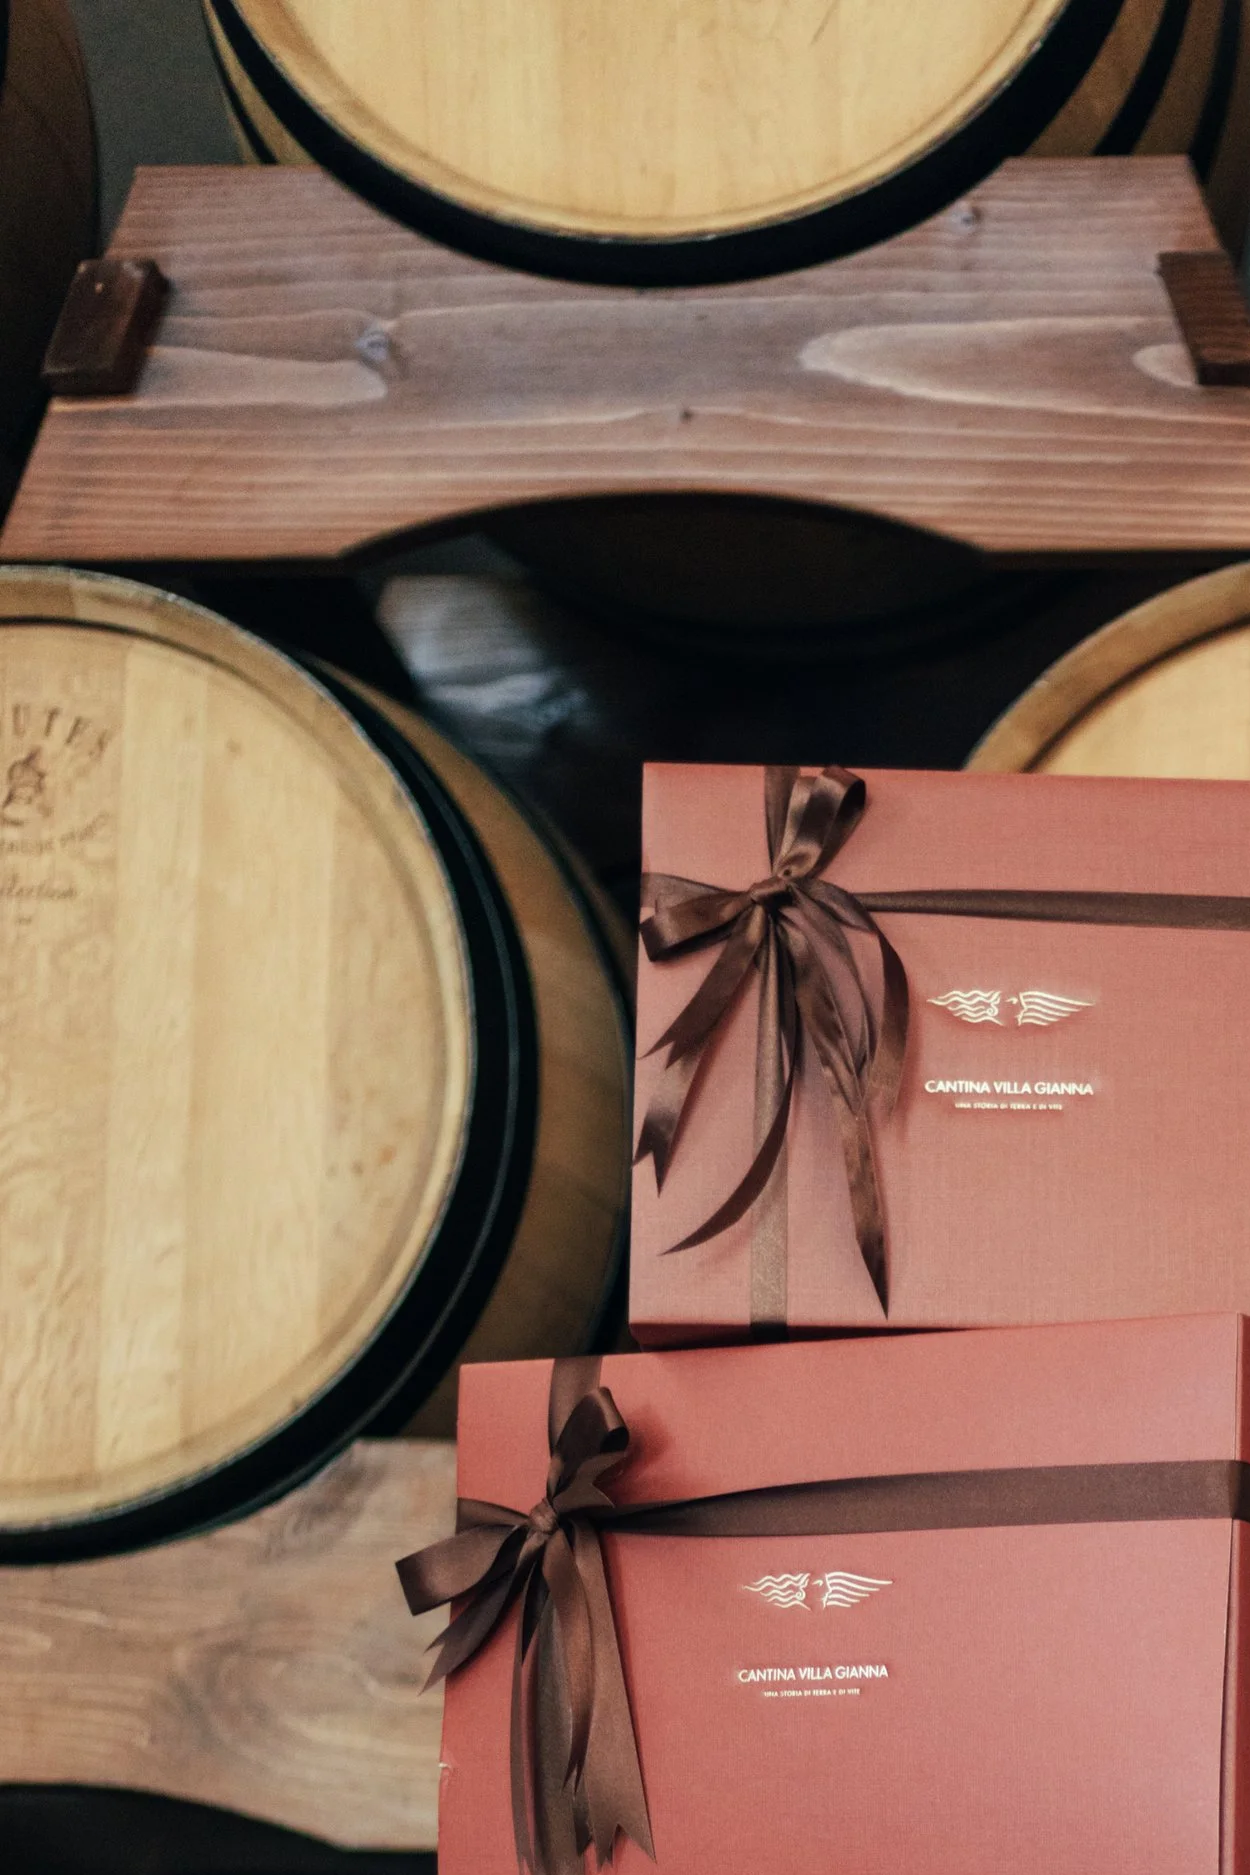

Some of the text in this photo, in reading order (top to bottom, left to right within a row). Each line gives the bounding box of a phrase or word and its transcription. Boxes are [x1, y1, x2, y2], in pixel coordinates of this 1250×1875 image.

[924, 1080, 1094, 1095] CANTINA VILLA GIANNA
[738, 1665, 888, 1682] CANTINA VILLA GIANNA
